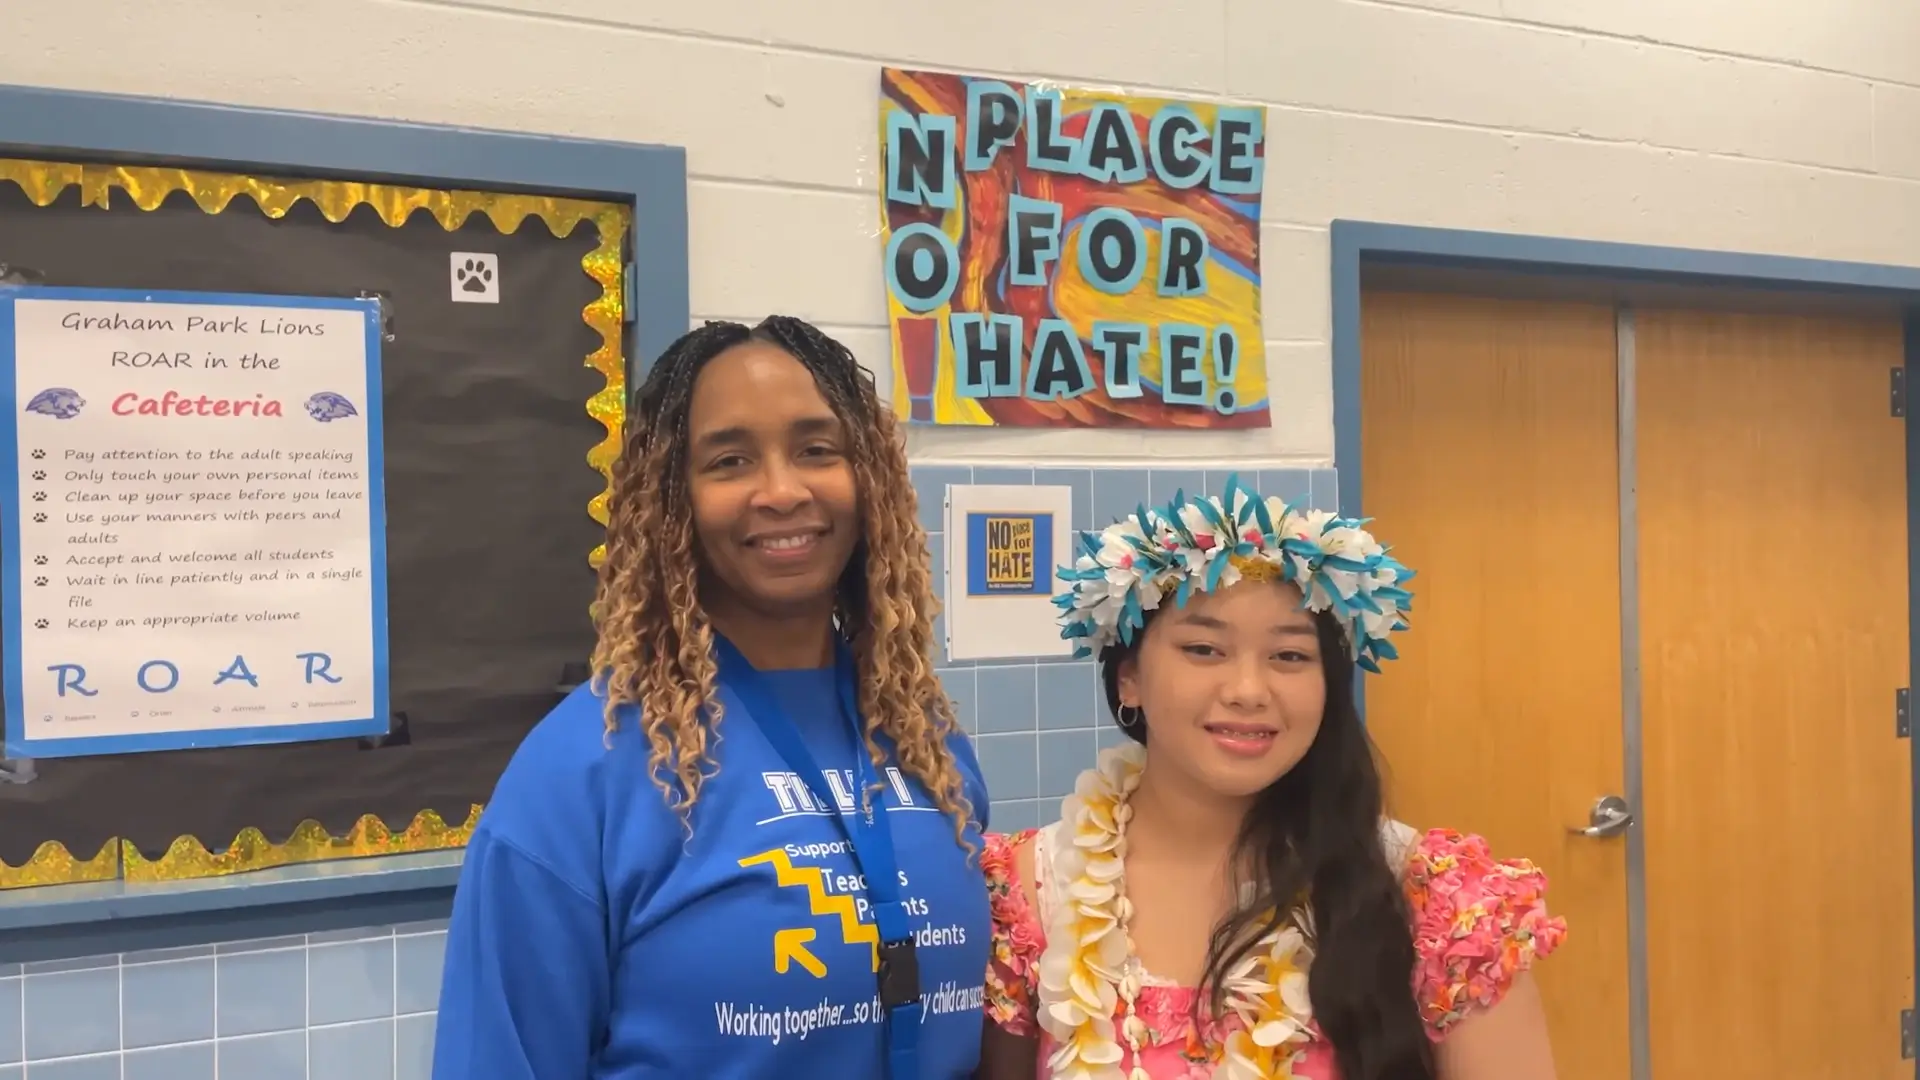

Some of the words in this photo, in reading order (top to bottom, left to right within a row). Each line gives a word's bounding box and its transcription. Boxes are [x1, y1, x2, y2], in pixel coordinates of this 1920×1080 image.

[973, 89, 1256, 186] PLACE
[1013, 209, 1206, 293] FOR
[62, 312, 174, 332] Graham
[187, 316, 248, 334] Park
[260, 317, 325, 336] Lions
[111, 351, 193, 369] ROAR
[204, 352, 228, 369] in
[239, 353, 281, 370] the
[961, 319, 1237, 409] HATE!
[111, 390, 284, 418] Cafeteria
[64, 449, 95, 463] Pay
[102, 449, 179, 460] attention
[186, 449, 202, 460] to
[209, 449, 234, 460] the
[241, 449, 281, 460] adult
[288, 449, 353, 463] speaking
[64, 469, 104, 484] Only
[111, 469, 157, 480] touch
[163, 471, 200, 483] your
[206, 471, 240, 480] own
[246, 469, 312, 483] personal
[318, 470, 360, 480] items
[65, 490, 111, 502] Clean
[118, 492, 139, 504] up
[145, 492, 183, 504] your
[189, 491, 232, 503] space
[238, 489, 286, 500] before
[292, 491, 319, 503] you
[326, 489, 362, 500] leave
[66, 512, 94, 523] Use
[101, 514, 140, 526] your
[146, 512, 217, 522] manners
[224, 509, 259, 521] with
[265, 511, 306, 524] peers
[312, 509, 341, 520] and
[67, 532, 119, 544] adults
[989, 521, 1012, 550] NO
[1014, 538, 1031, 550] for
[65, 554, 124, 568] Accept
[131, 551, 162, 563] and
[169, 550, 237, 563] welcome
[244, 549, 262, 561] all
[269, 548, 334, 560] students
[989, 552, 1032, 578] HATE
[66, 574, 106, 586] Wait
[113, 574, 128, 585] in
[135, 573, 164, 585] line
[170, 571, 243, 587] patiently
[249, 569, 279, 581] and
[285, 569, 300, 580] in
[306, 570, 315, 579] a
[321, 567, 363, 582] single
[68, 595, 93, 607] file
[67, 617, 108, 631] Keep
[115, 618, 136, 627] an
[143, 612, 239, 629] appropriate
[245, 610, 301, 623] volume
[762, 769, 856, 813] TIL
[821, 868, 909, 893] Teacs
[715, 1002, 781, 1046] Working
[932, 980, 957, 1014] child
